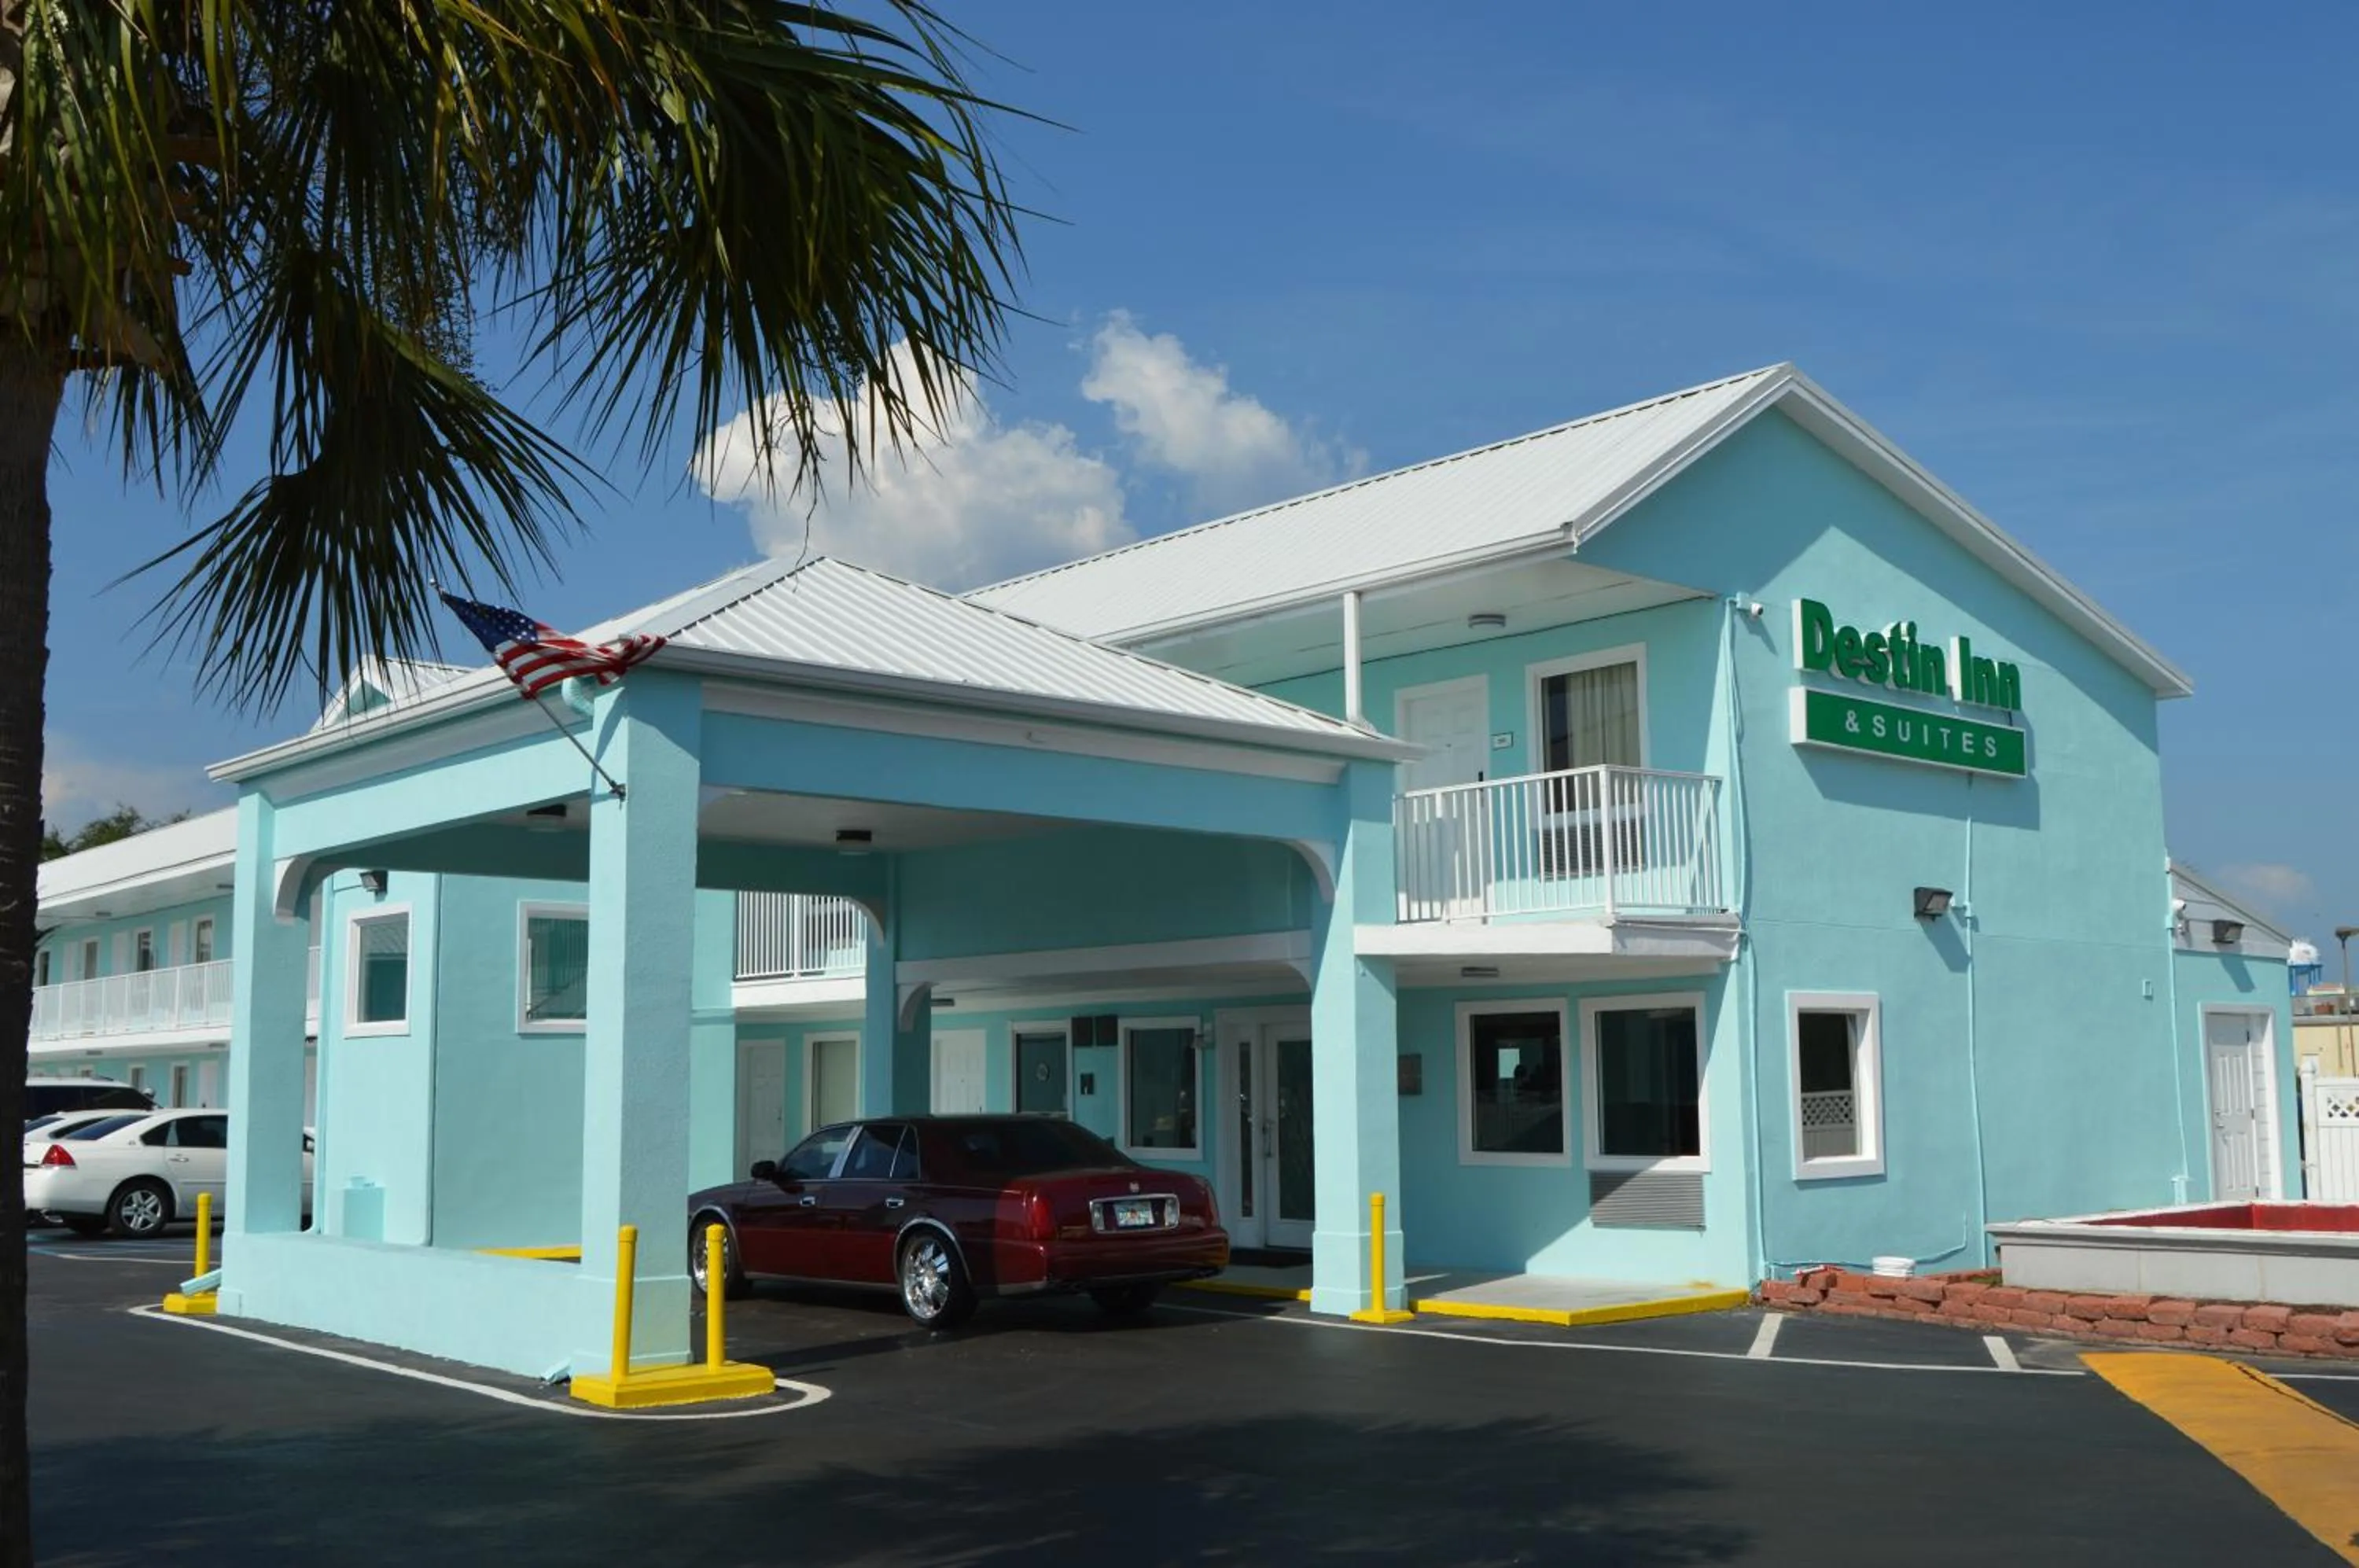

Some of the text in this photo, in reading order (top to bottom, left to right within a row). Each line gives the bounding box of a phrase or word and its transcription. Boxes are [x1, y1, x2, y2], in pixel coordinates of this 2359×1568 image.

[1797, 598, 2022, 710] Destin Inn
[1846, 710, 1997, 757] & SUITES
